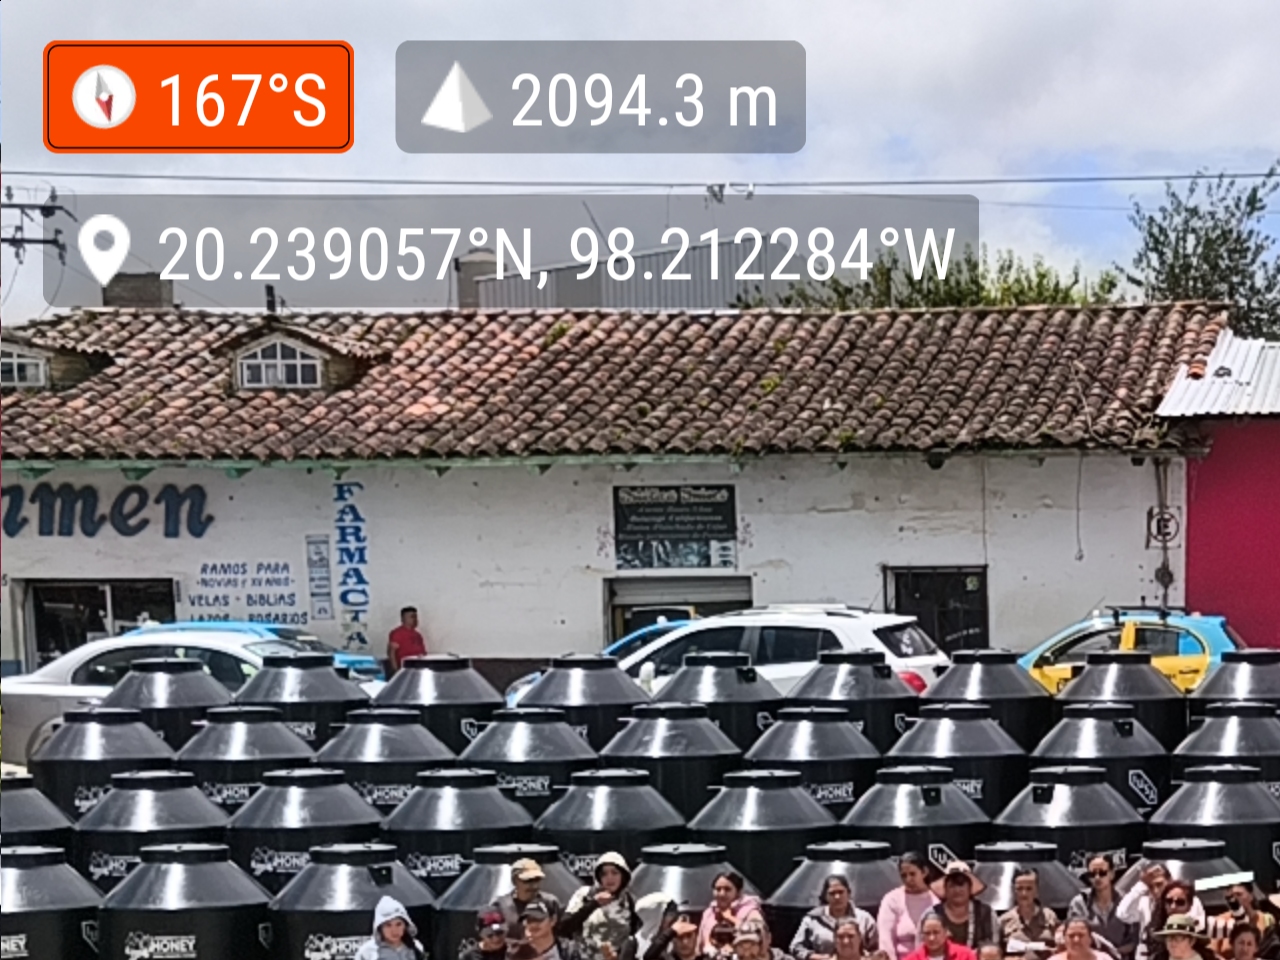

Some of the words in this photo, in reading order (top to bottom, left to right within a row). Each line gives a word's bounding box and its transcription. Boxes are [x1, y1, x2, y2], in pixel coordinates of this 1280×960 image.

[200, 562, 248, 576] RAMOS
[256, 562, 291, 575] PARA
[188, 594, 230, 607] VELAS
[222, 787, 249, 798] HON
[274, 855, 307, 868] HONE
[427, 858, 460, 872] HONE
[151, 939, 195, 952] HONEY
[333, 941, 362, 955] HON
